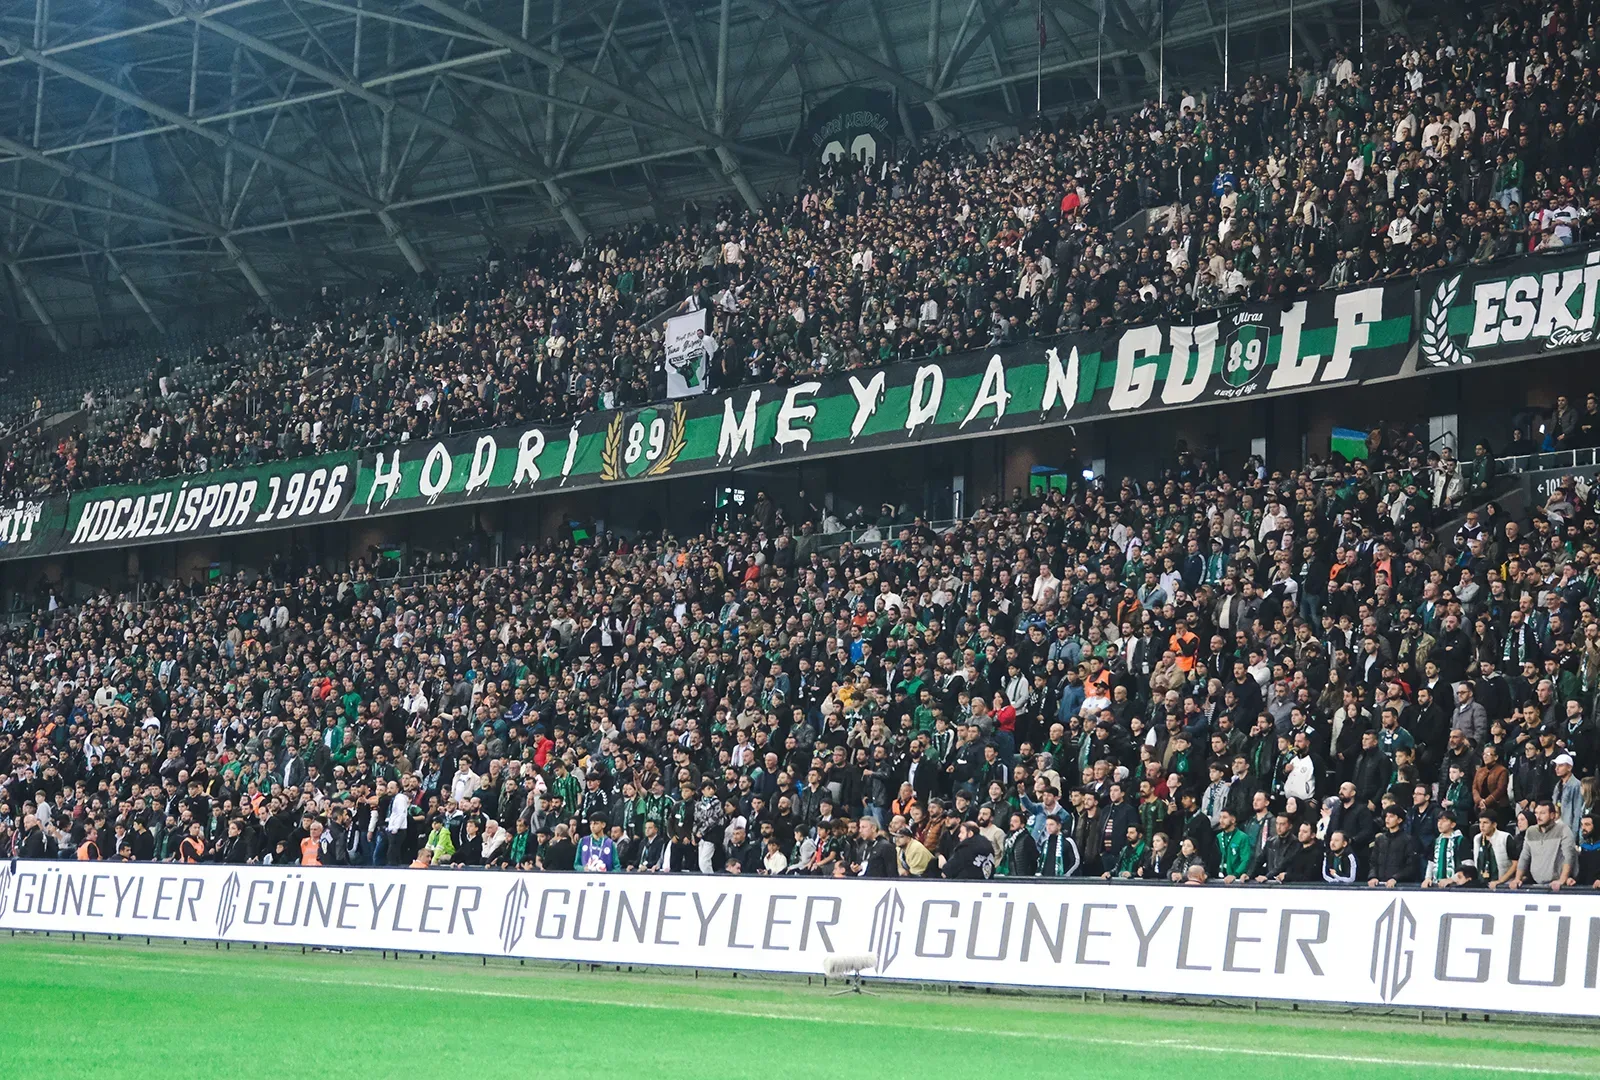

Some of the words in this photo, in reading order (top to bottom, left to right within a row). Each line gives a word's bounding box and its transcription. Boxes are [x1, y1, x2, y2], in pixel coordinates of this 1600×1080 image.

[1108, 287, 1384, 411] GULF
[1227, 338, 1261, 373] 89
[1546, 327, 1592, 348] Since
[716, 345, 1079, 467] MEYDAN
[624, 417, 664, 464] 89
[70, 480, 258, 544] KOCAELİSPOR
[256, 465, 348, 522] 1966
[13, 867, 205, 922] GÜNEYLER
[243, 874, 482, 934] GÜNEYLER
[534, 882, 842, 953] GÜNEYLER
[913, 892, 1330, 976] GÜNEYLER
